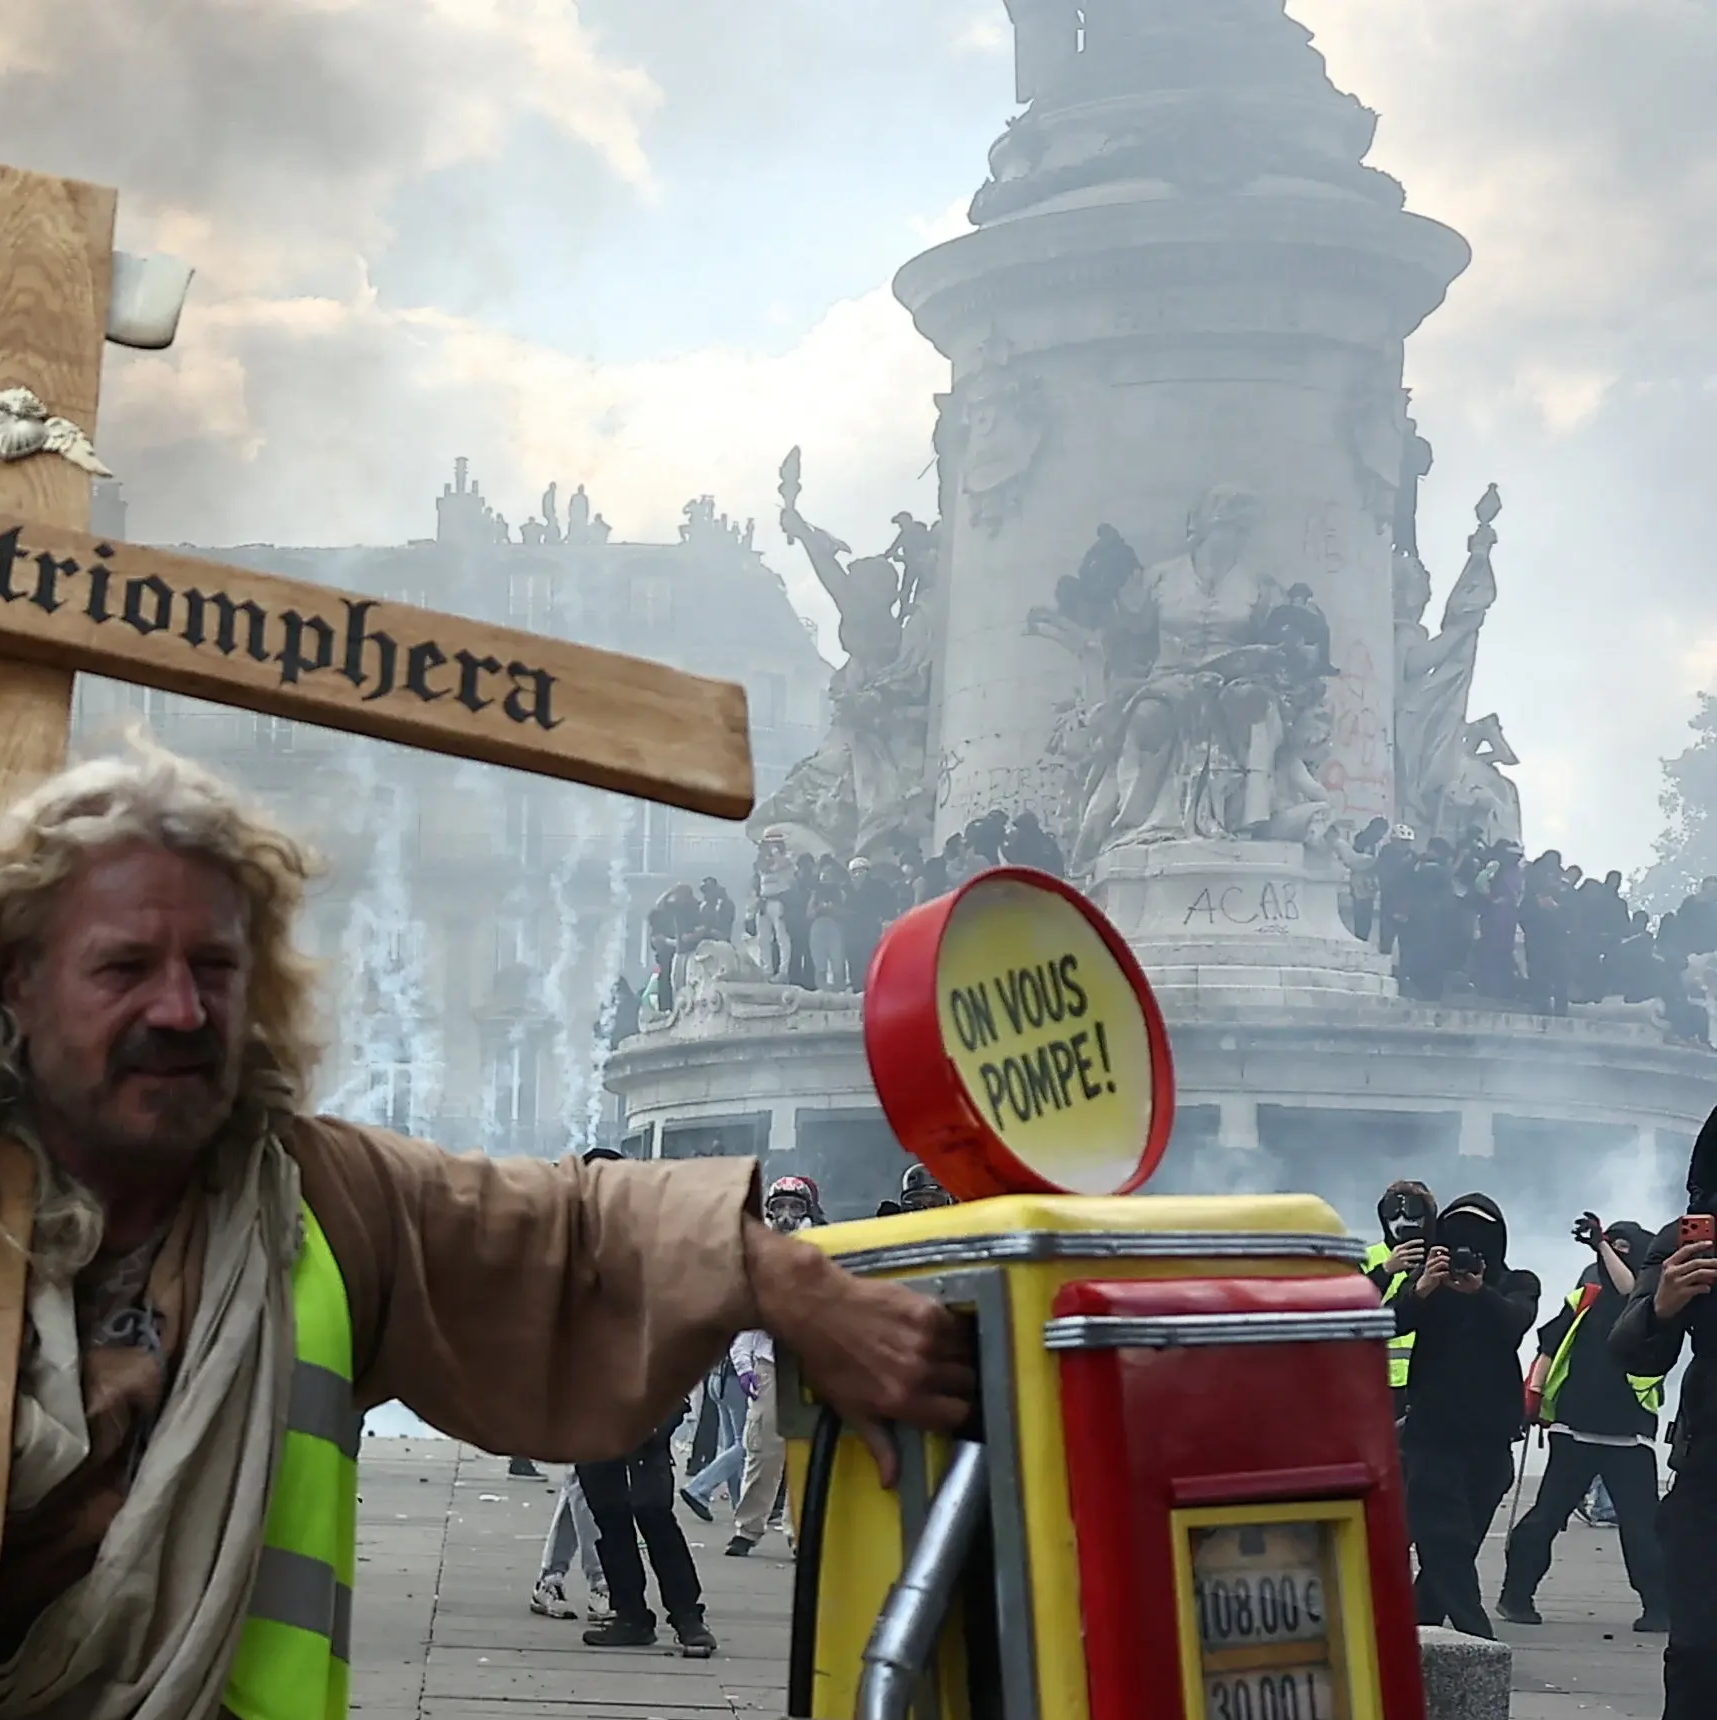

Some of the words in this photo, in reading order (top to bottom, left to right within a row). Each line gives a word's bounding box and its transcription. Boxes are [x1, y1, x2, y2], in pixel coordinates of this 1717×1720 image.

[1182, 881, 1299, 925] ACAB
[950, 981, 998, 1052] ON
[994, 953, 1088, 1035] VOUS
[980, 1021, 1116, 1131] POMPE!
